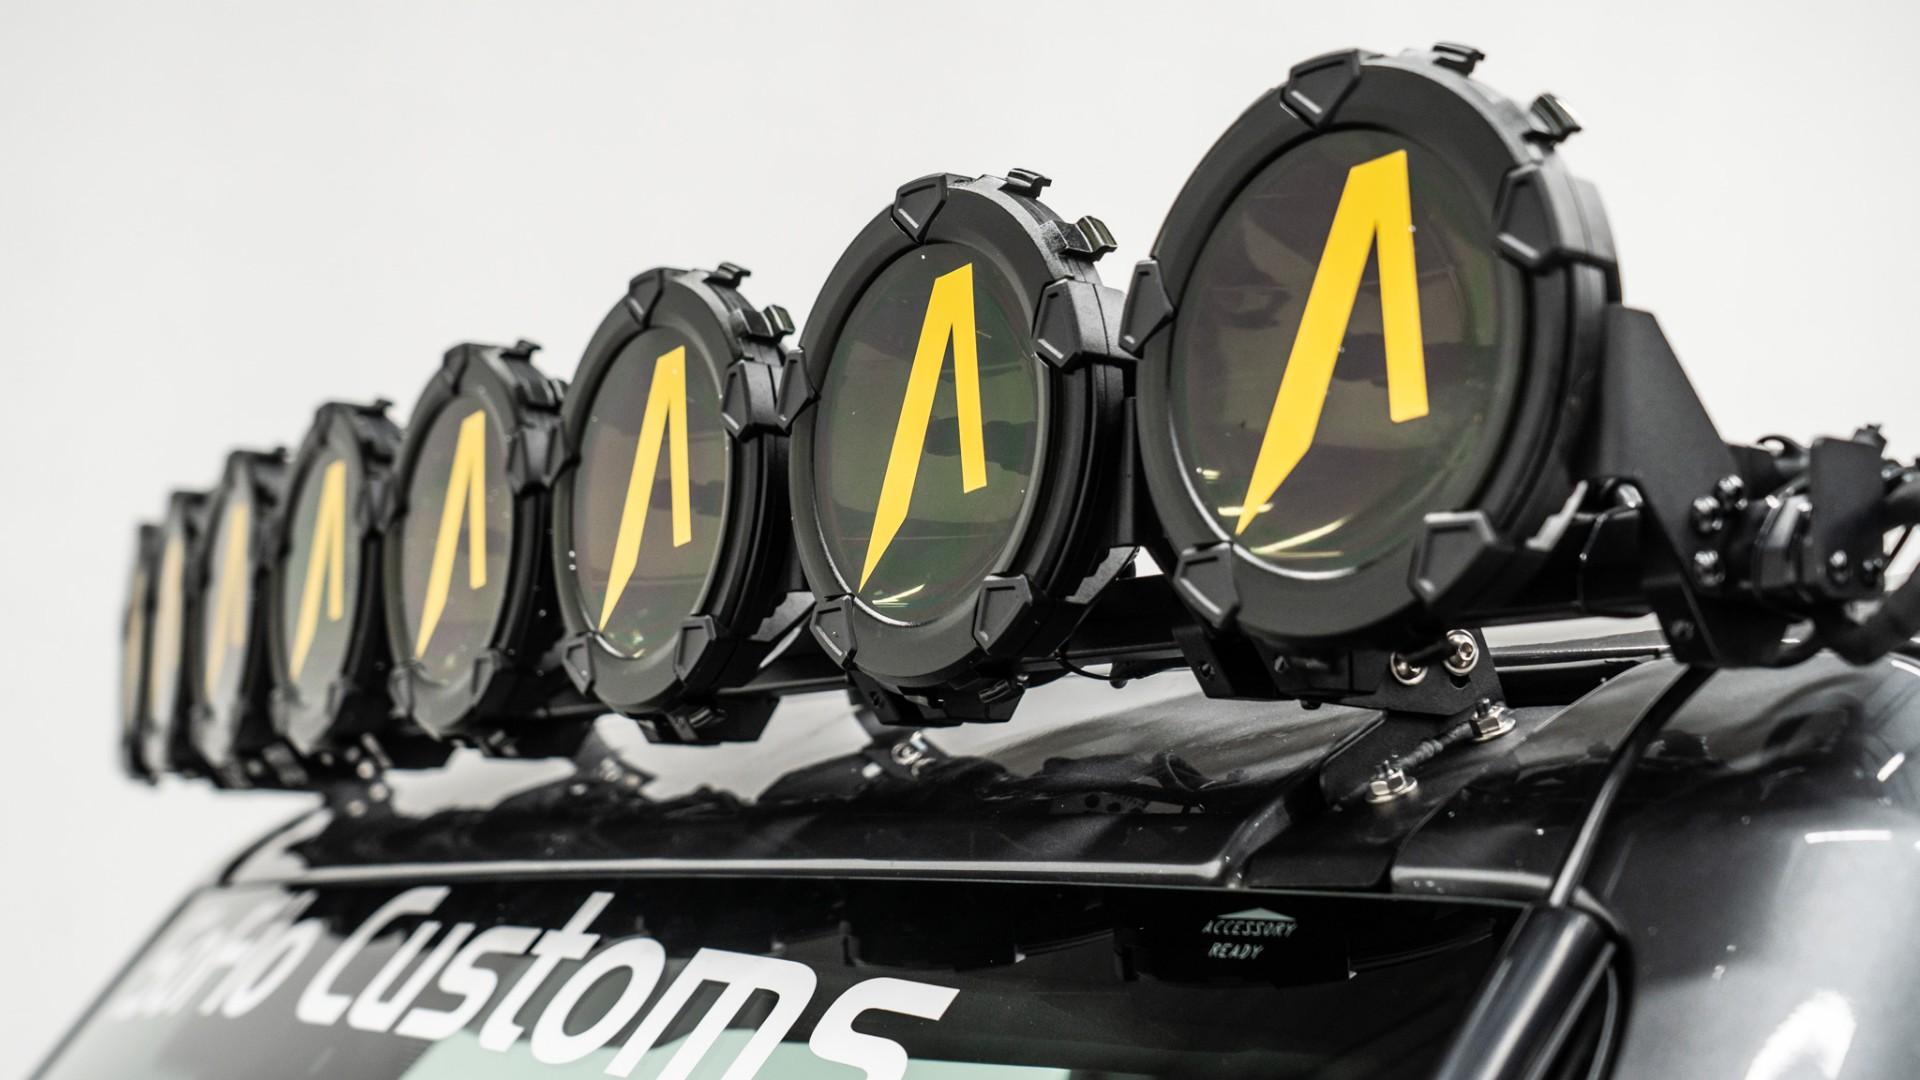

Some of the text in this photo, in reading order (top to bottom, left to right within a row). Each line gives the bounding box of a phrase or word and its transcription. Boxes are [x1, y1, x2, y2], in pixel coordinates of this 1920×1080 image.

[1201, 919, 1297, 937] ACCESSORY
[1208, 942, 1264, 960] READY
[295, 886, 960, 1080] Customs
